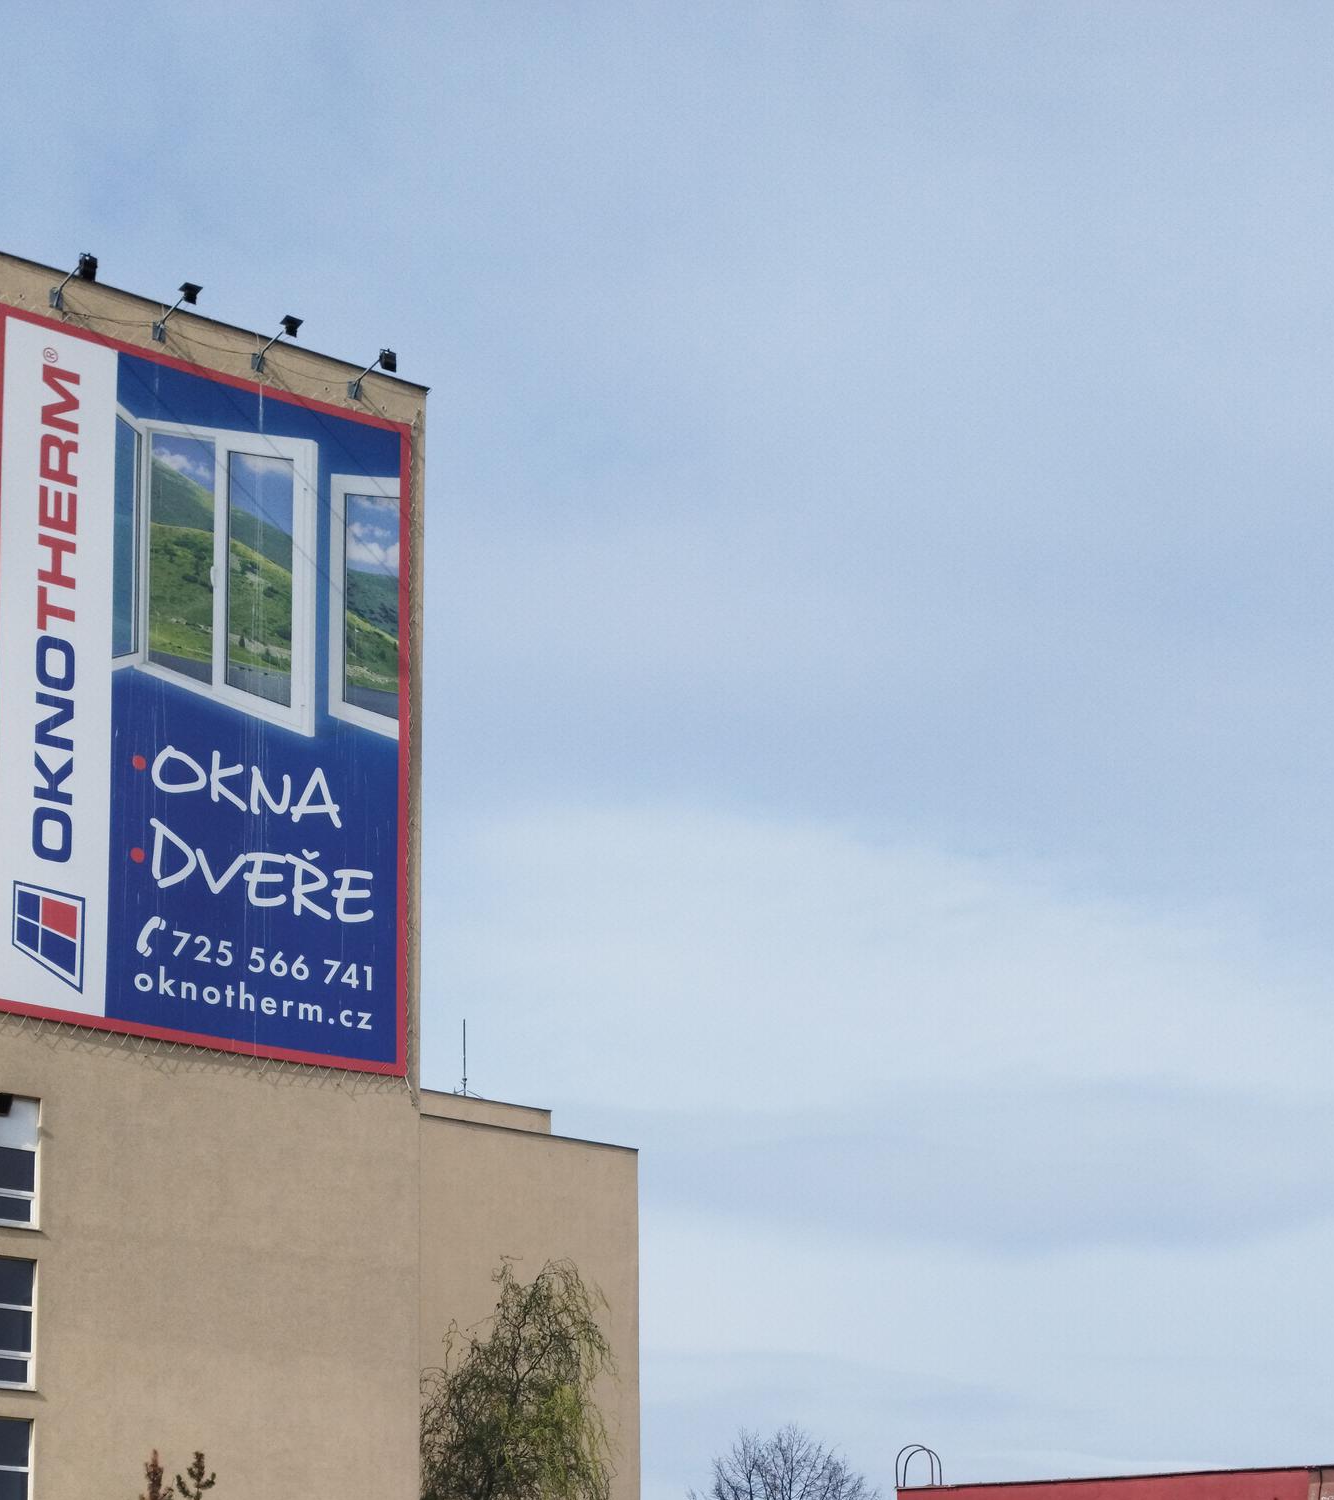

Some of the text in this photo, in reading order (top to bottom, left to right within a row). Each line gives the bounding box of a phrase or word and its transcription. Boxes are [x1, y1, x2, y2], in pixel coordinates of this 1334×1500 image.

[151, 745, 341, 829] OKNA
[150, 817, 374, 923] DVEŘE
[134, 965, 373, 1030] oknotherm.cz
[172, 930, 373, 991] 725 566 741
